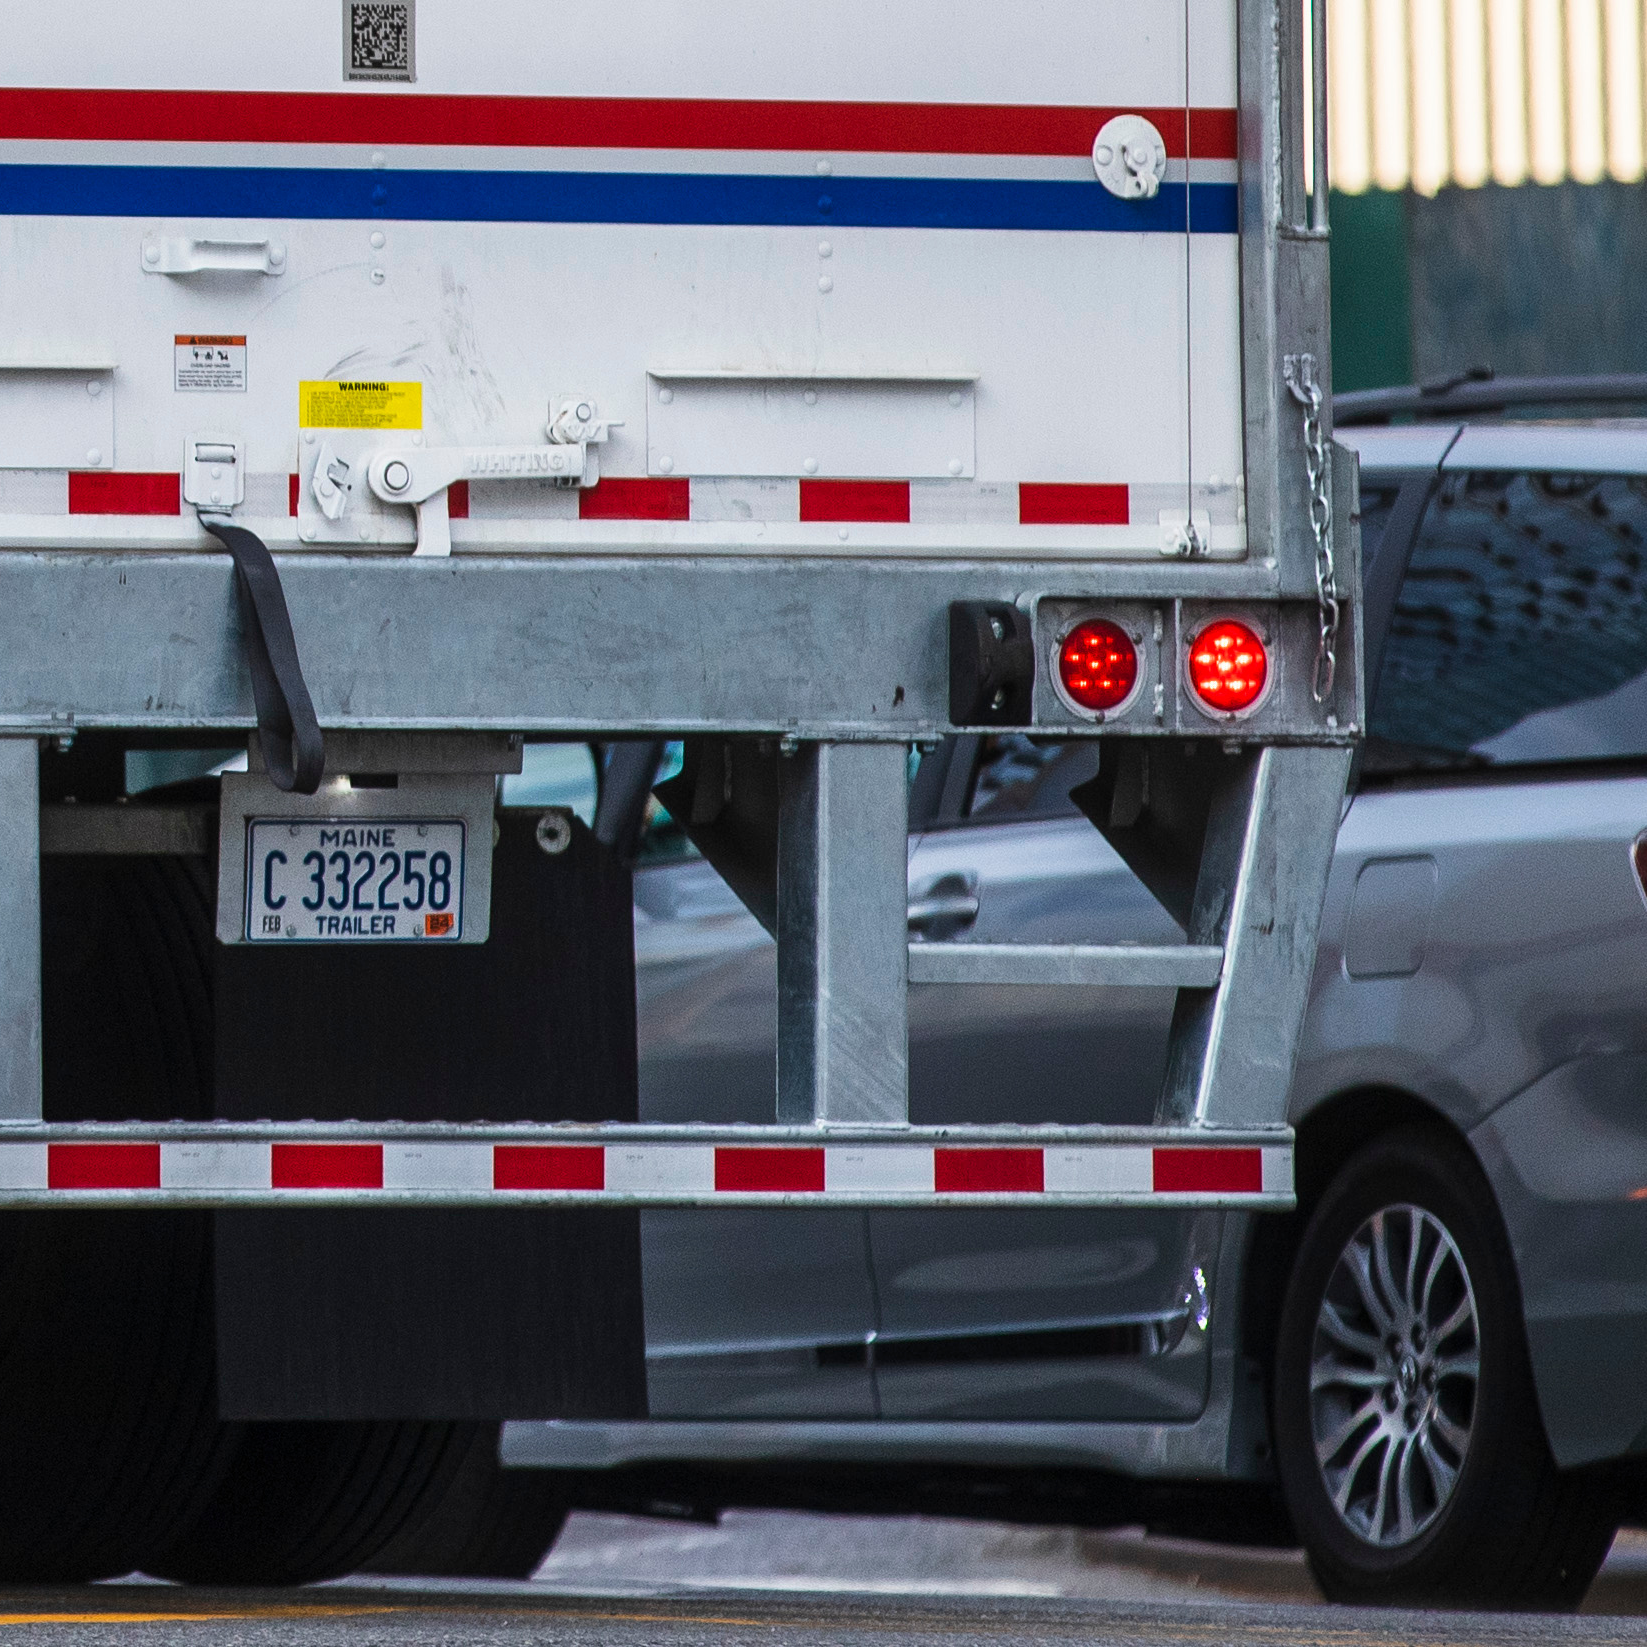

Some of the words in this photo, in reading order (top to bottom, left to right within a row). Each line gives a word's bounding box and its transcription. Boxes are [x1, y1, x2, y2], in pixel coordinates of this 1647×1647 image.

[338, 381, 390, 392] WARNING:
[469, 453, 565, 474] WHITING
[319, 828, 396, 847] MAINE
[263, 850, 288, 911] C
[302, 849, 452, 912] 332258
[261, 914, 282, 933] FEB
[315, 915, 396, 935] TRAILER
